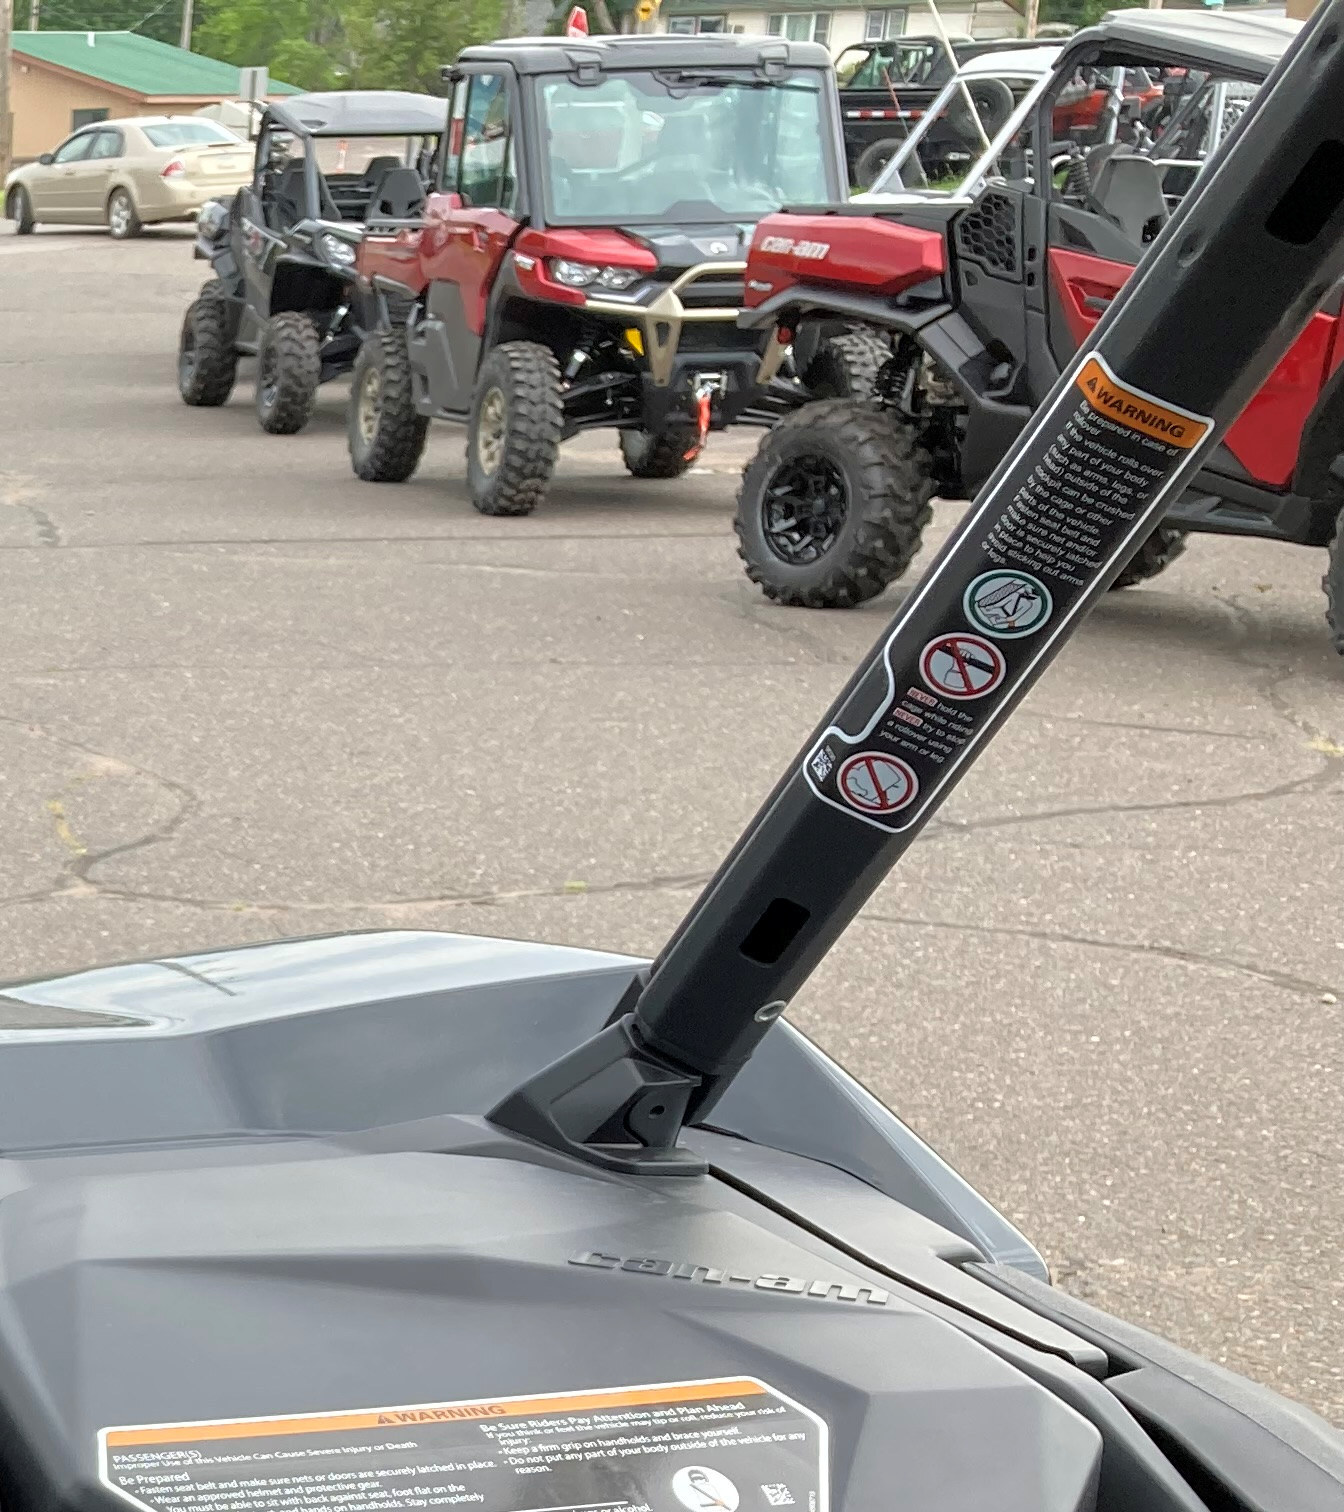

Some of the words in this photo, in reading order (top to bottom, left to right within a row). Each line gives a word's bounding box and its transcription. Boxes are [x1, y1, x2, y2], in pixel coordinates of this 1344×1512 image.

[1096, 386, 1186, 438] WARNING
[567, 1252, 889, 1305] can-am
[395, 1405, 507, 1422] WARNING
[112, 1449, 202, 1463] PASSENGER(S)
[118, 1476, 135, 1486] Be
[135, 1472, 190, 1485] Prepared
